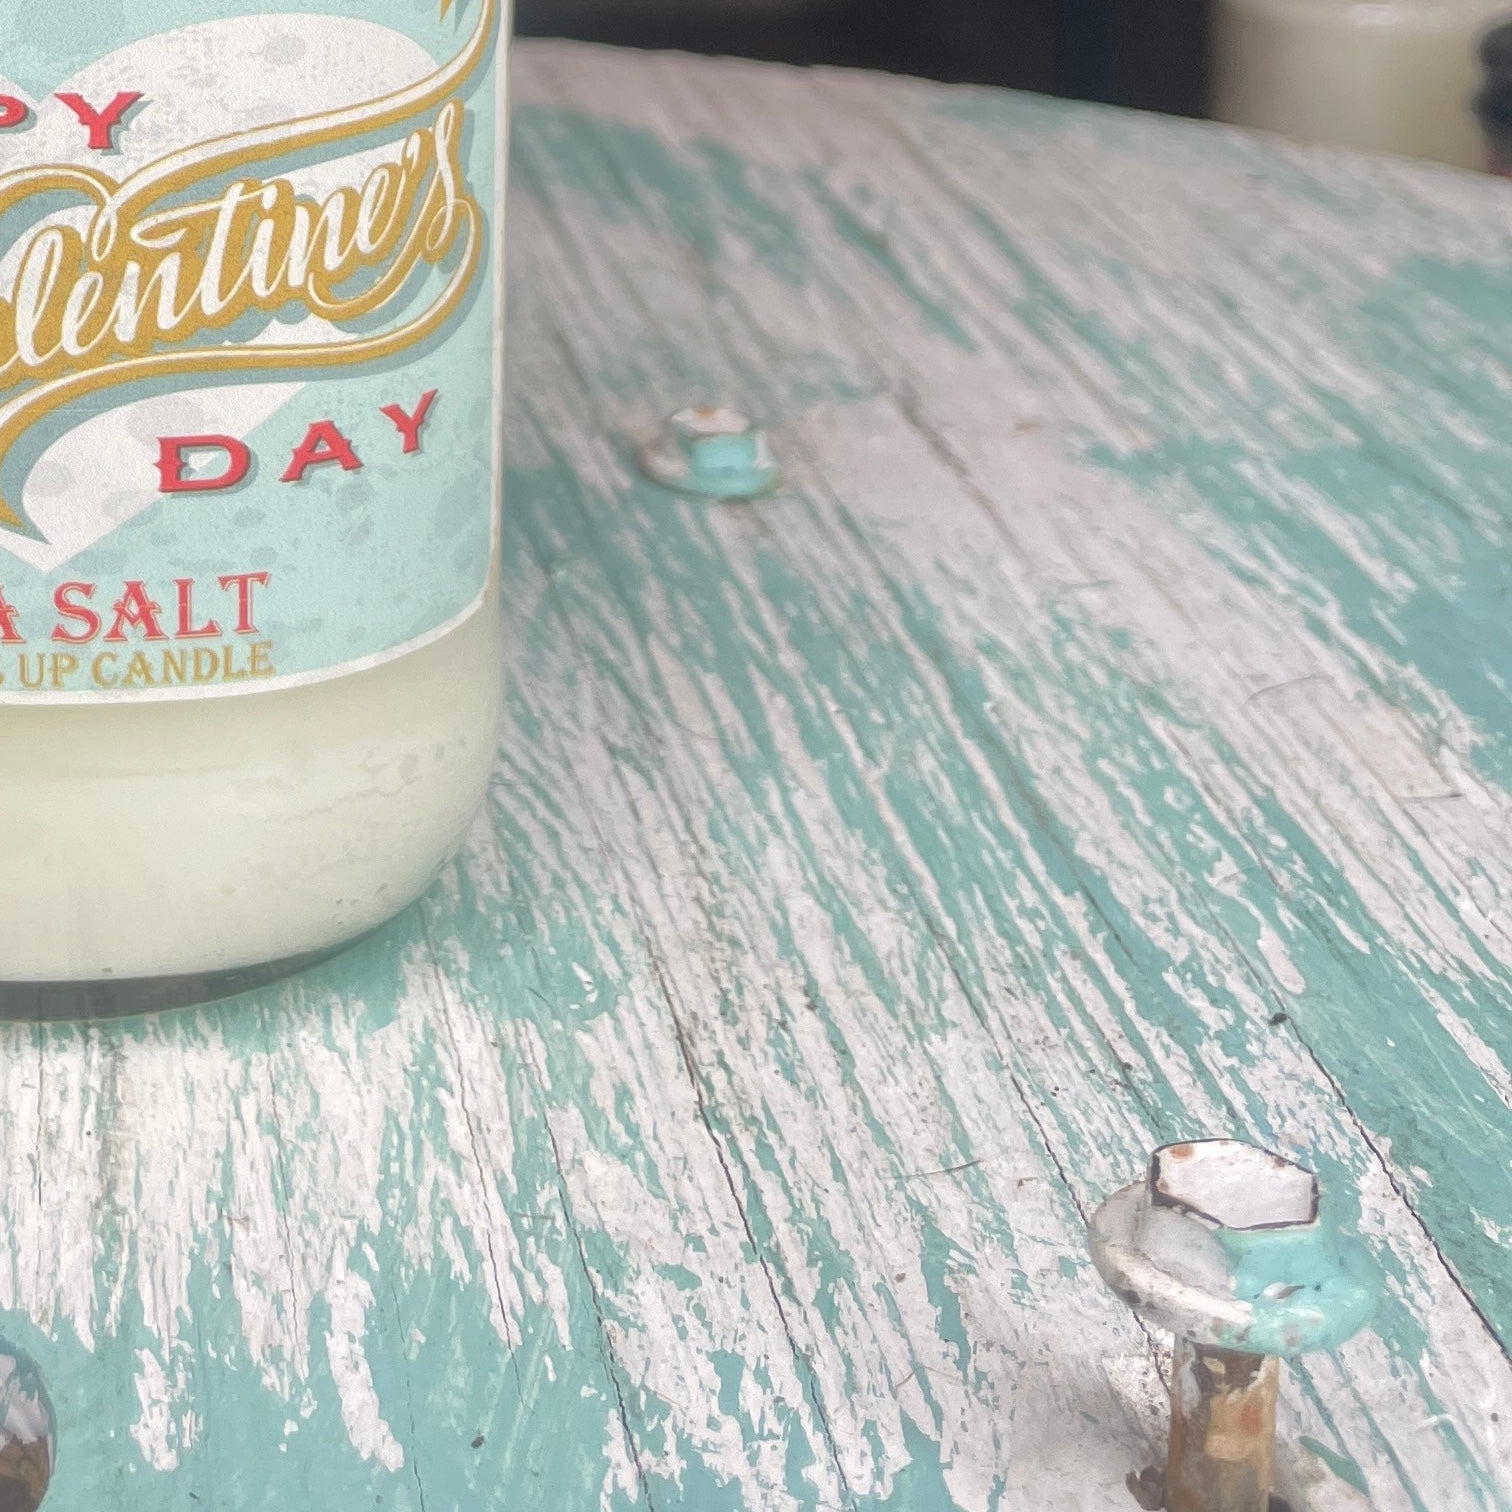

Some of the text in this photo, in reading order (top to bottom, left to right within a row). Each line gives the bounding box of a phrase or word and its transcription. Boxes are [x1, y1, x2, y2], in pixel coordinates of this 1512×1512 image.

[153, 387, 440, 496] DAY
[50, 570, 272, 645] SALT
[18, 650, 80, 690] UP
[90, 640, 277, 688] CANDLE
